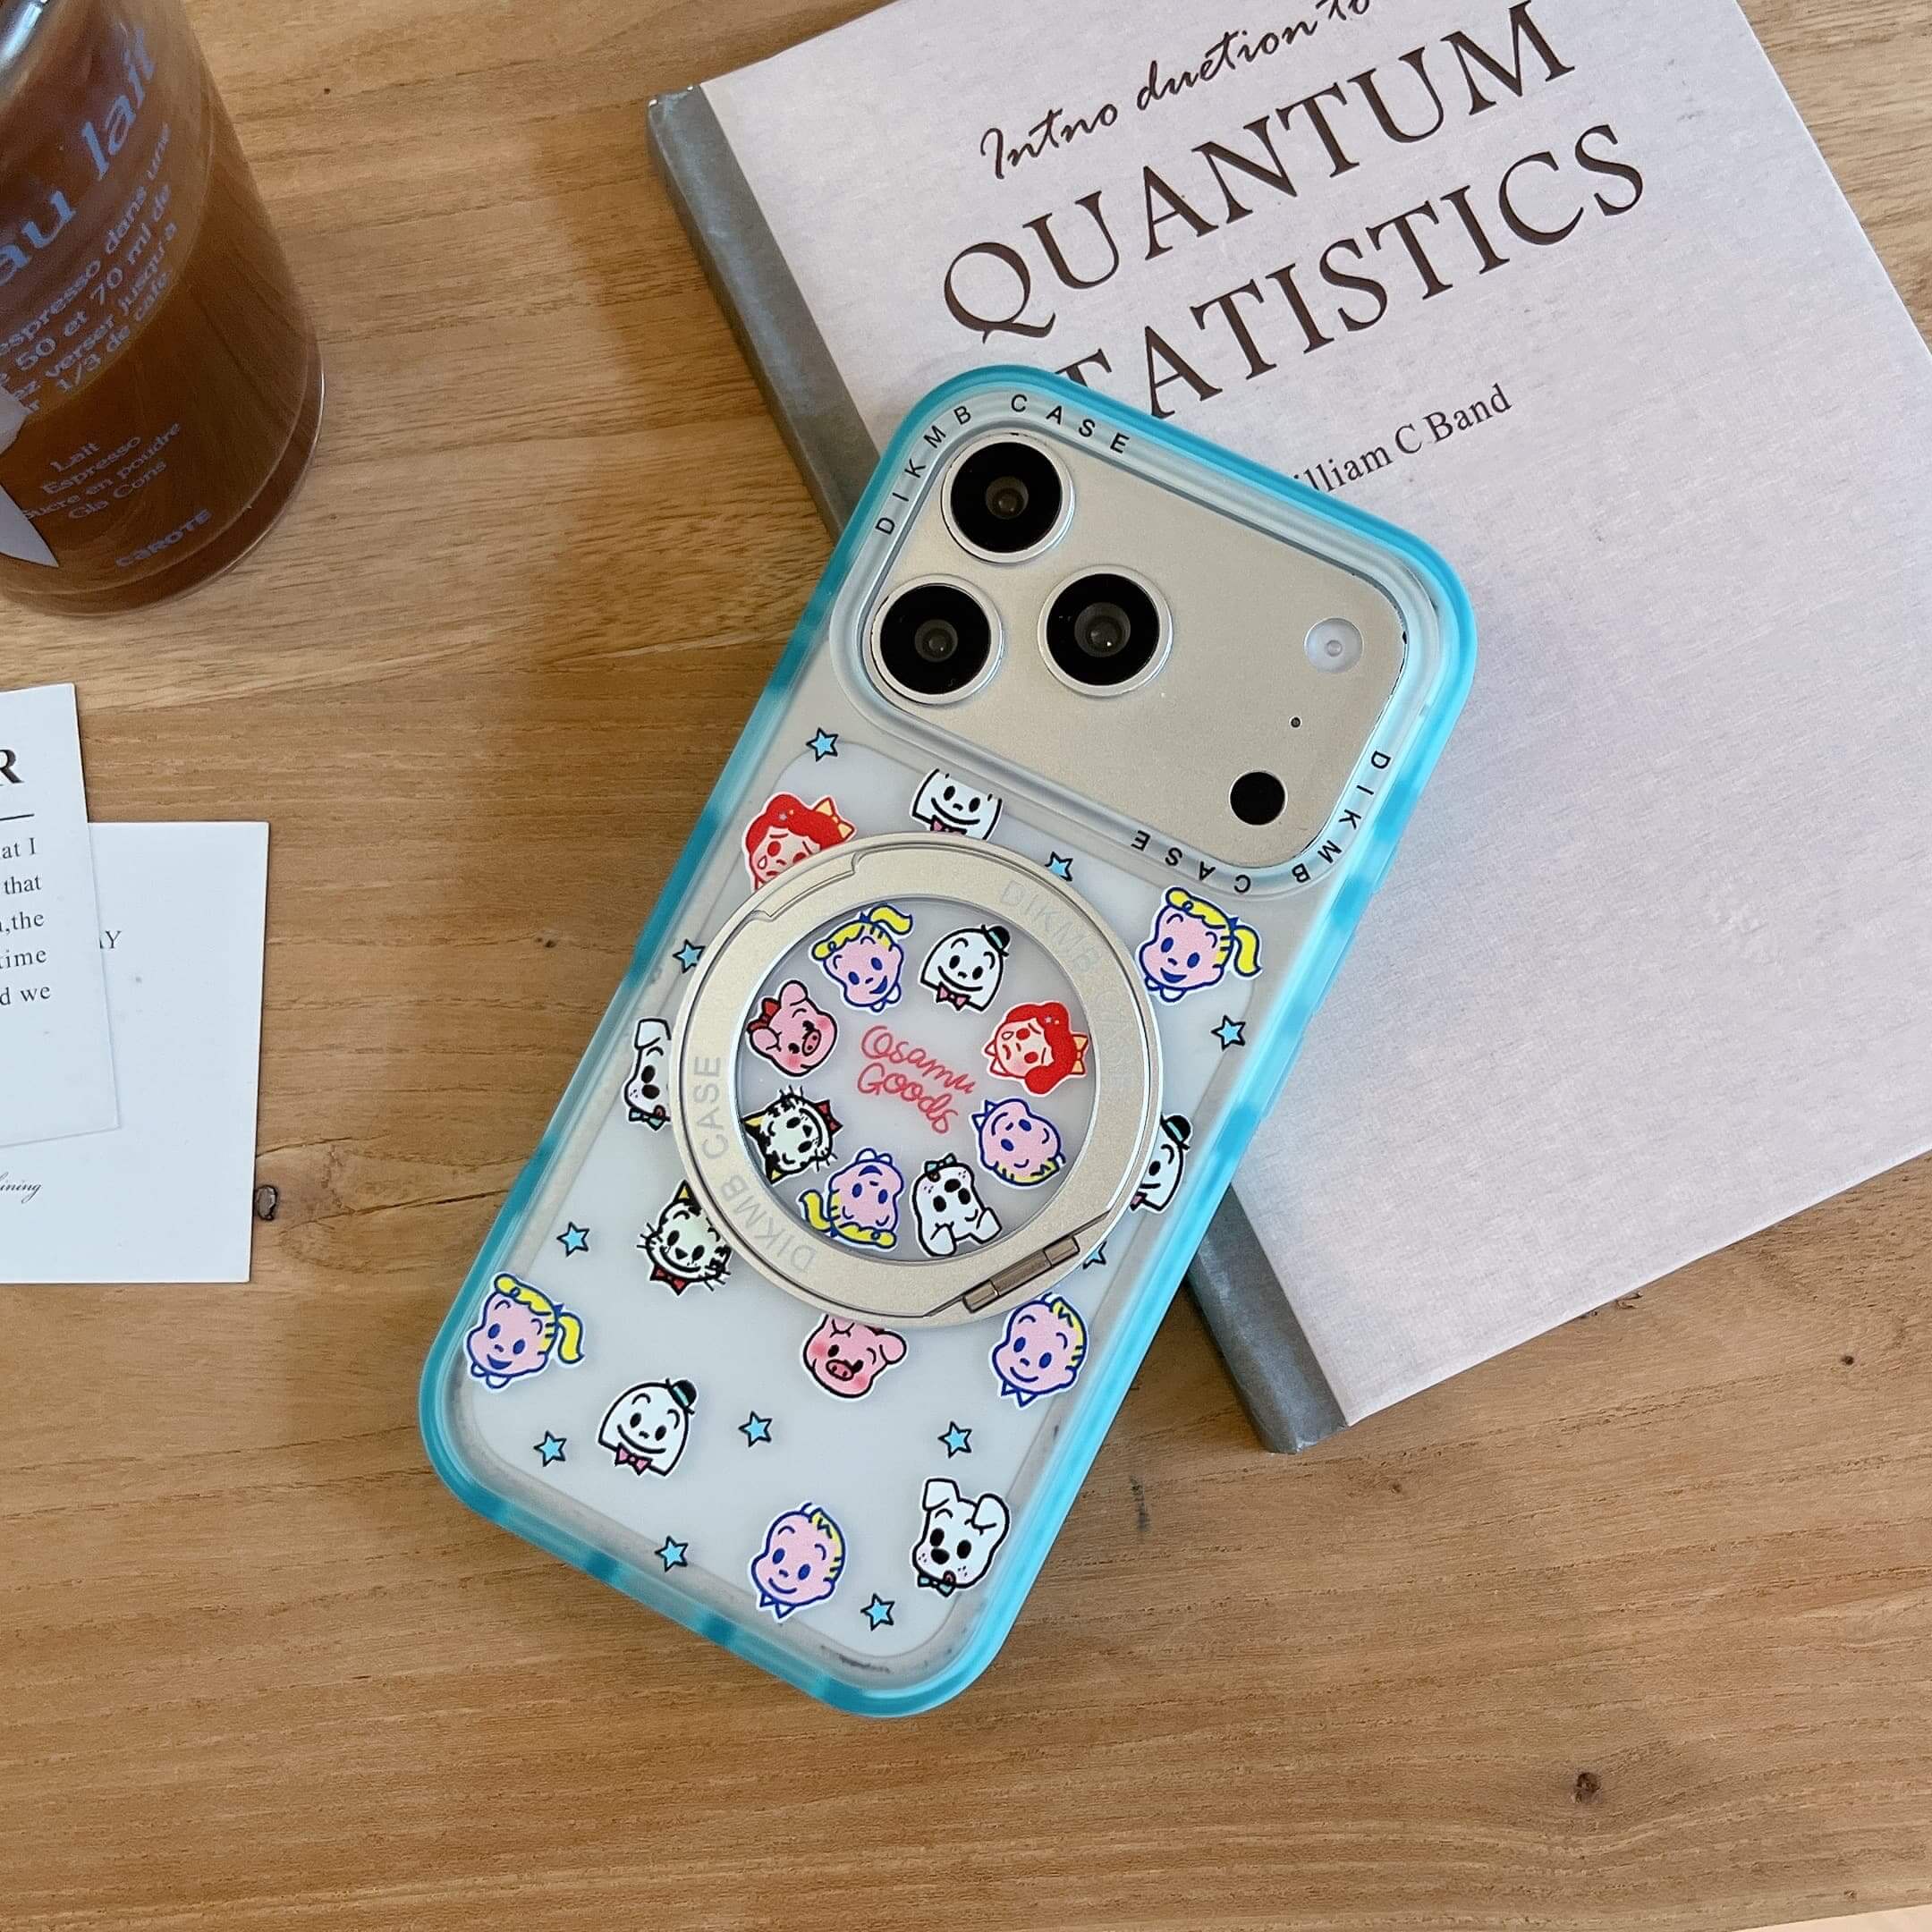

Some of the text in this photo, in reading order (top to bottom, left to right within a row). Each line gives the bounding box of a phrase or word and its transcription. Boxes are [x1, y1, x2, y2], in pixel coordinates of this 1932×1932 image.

[943, 0, 1576, 344] QUANTUM
[1055, 124, 1644, 419] TATISTICS
[1394, 422, 1422, 454] C
[1422, 382, 1513, 445] Band
[875, 394, 1131, 536] DIKMB CASE
[30, 837, 37, 856] I
[1130, 750, 1392, 894] DIKMB CASE
[4, 875, 42, 897] that
[20, 986, 51, 1002] we
[860, 1025, 977, 1094] Osamu
[857, 1062, 959, 1134] Goods
[692, 1055, 817, 1274] DIKMB CASE
